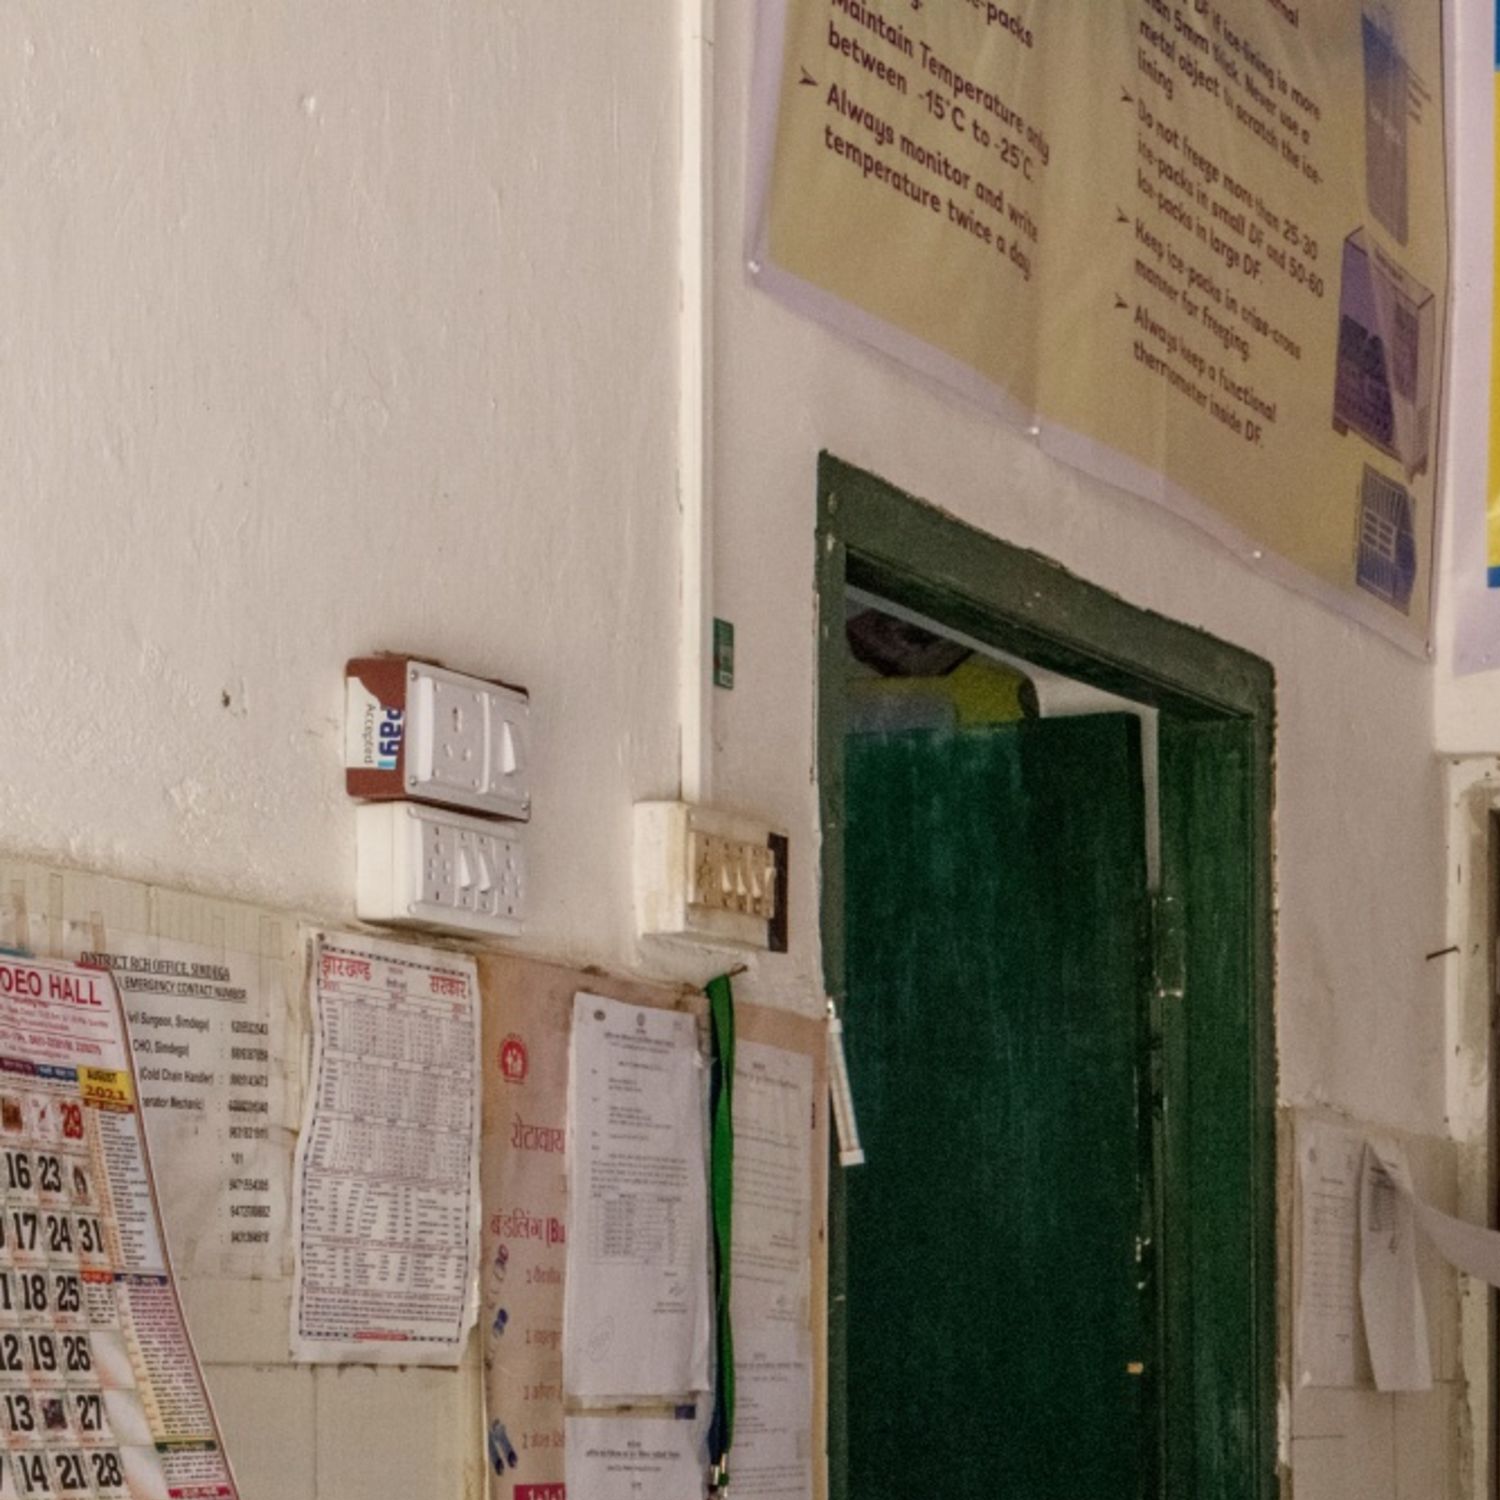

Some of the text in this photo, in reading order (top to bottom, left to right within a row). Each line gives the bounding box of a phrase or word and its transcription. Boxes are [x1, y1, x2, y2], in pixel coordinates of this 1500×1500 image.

[828, 20, 990, 148] between to
[919, 41, 1050, 168] Temperature only
[826, 82, 1039, 244] Always monitor and write
[1138, 97, 1317, 261] Do not freeze more than 25-30
[824, 124, 1006, 255] temperature twice a
[1137, 131, 1324, 299] ice-packs in small and 50-60
[47, 973, 102, 1006] HALL
[322, 952, 468, 1000] झारखण्ड सरकार
[6, 1151, 62, 1194] 16 23
[13, 1213, 105, 1254] 17 24 31
[21, 1272, 81, 1313] 18 25
[28, 1334, 92, 1372] 19 26
[6, 1394, 104, 1433] 13 27
[20, 1452, 123, 1493] 14 21 28
